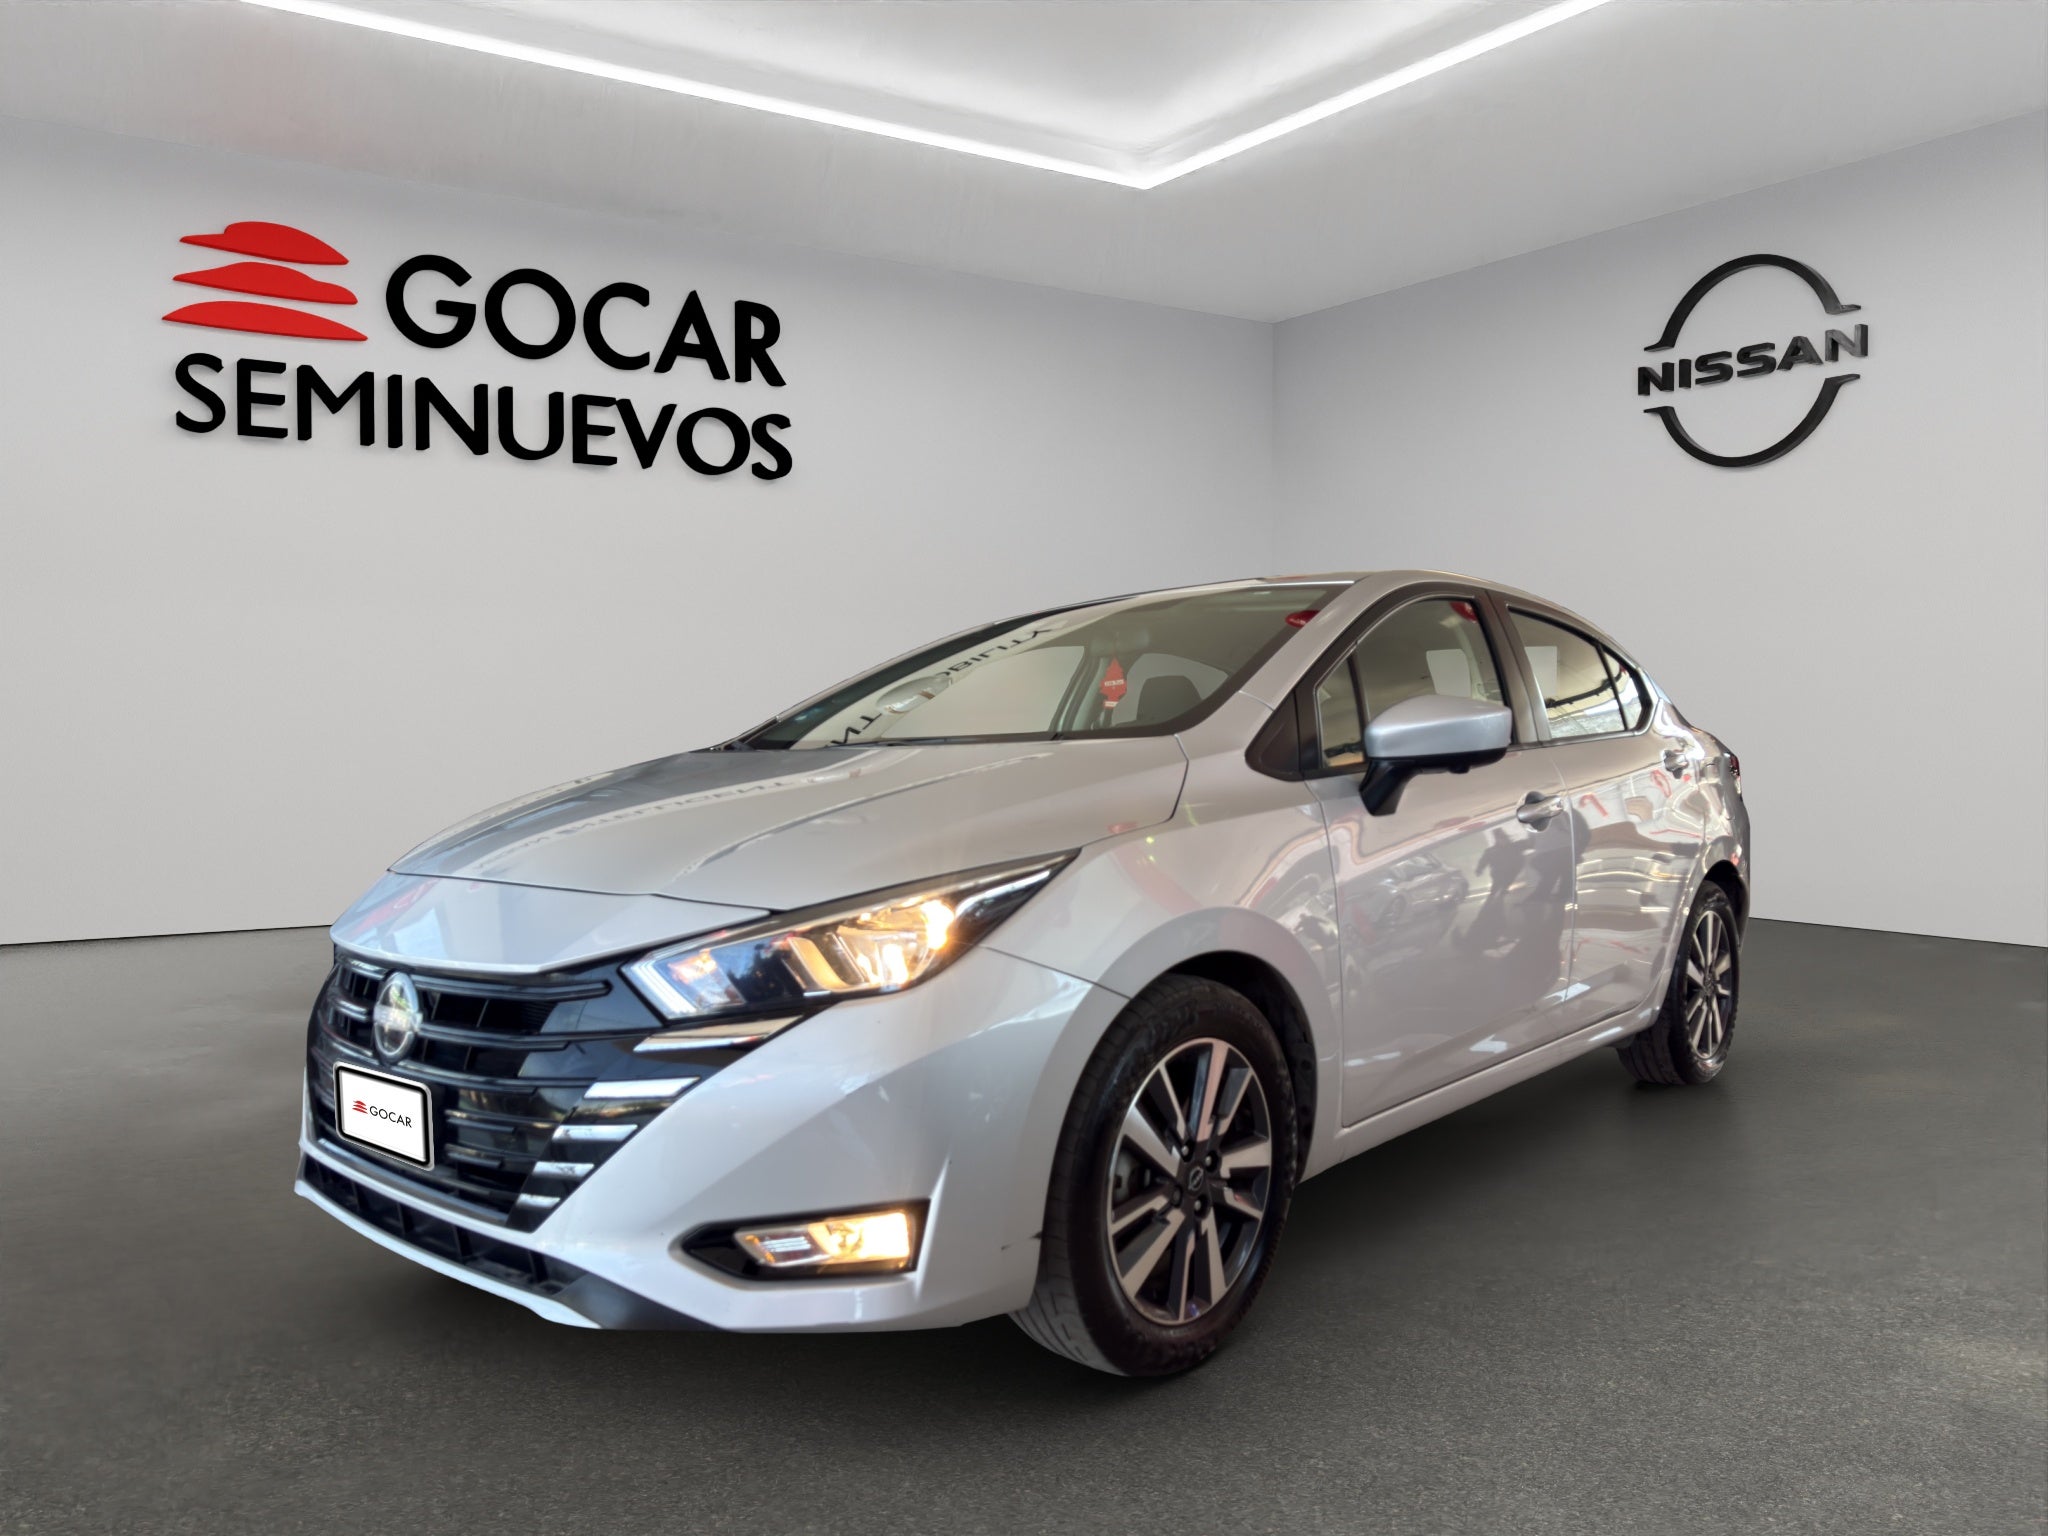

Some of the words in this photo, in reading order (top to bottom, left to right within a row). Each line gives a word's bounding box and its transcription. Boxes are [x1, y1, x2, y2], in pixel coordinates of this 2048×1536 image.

[385, 254, 787, 387] GOCAR
[1637, 323, 1869, 397] NISSAN
[174, 352, 794, 481] SEMINUEVOS
[369, 1105, 412, 1128] GOCAR
